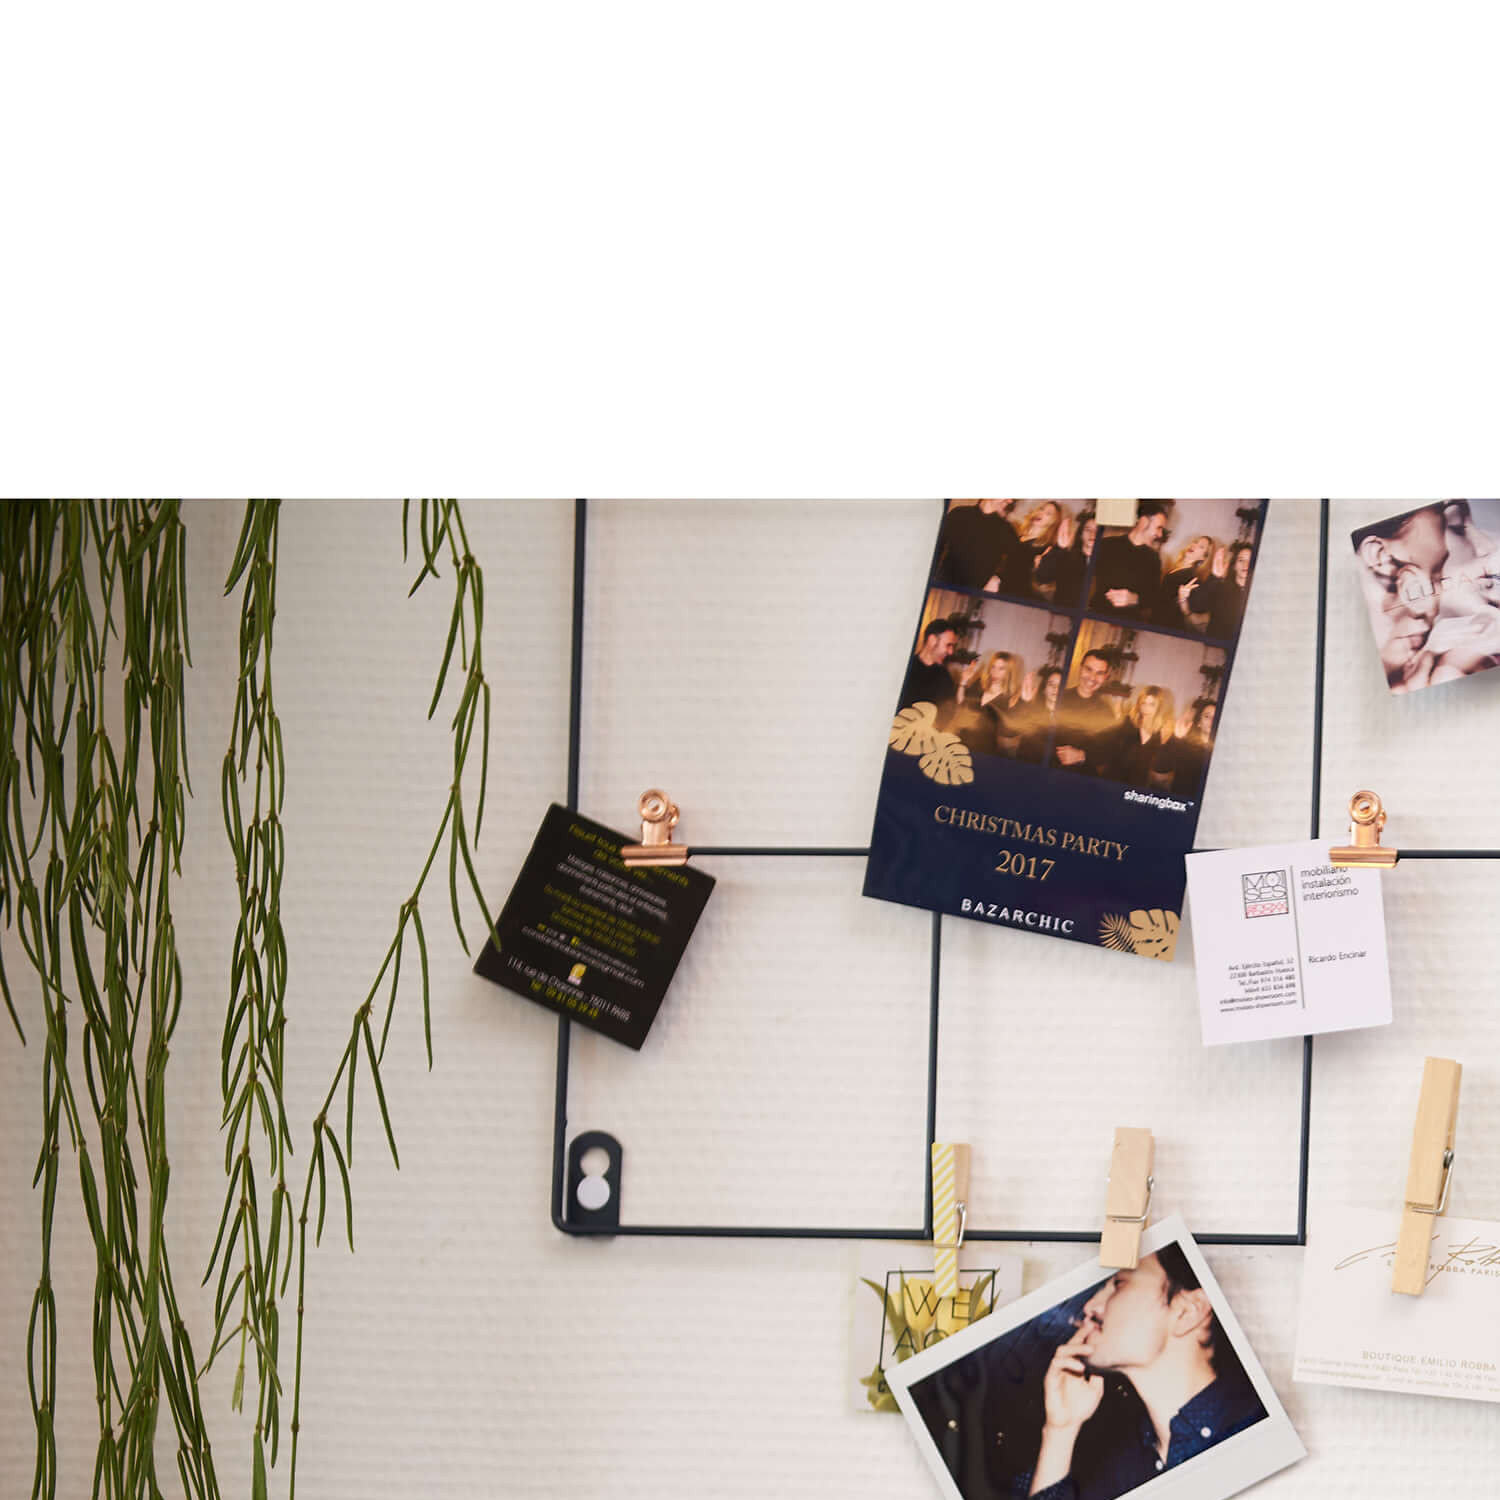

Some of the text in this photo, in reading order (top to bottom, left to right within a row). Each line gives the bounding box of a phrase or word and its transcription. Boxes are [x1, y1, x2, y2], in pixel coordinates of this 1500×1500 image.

[934, 803, 1130, 862] CHRISTMAS PARTY
[995, 848, 1056, 882] 2017
[1302, 876, 1352, 889] instalación
[1303, 887, 1360, 901] interiorismo
[960, 897, 1076, 934] BAZARCHIC
[1308, 950, 1367, 963] Ricardo Encinar
[1470, 1267, 1500, 1277] PARIS
[903, 1283, 973, 1320] WE
[1361, 1350, 1497, 1372] BOUTIQUE EMILIO ROBBA
